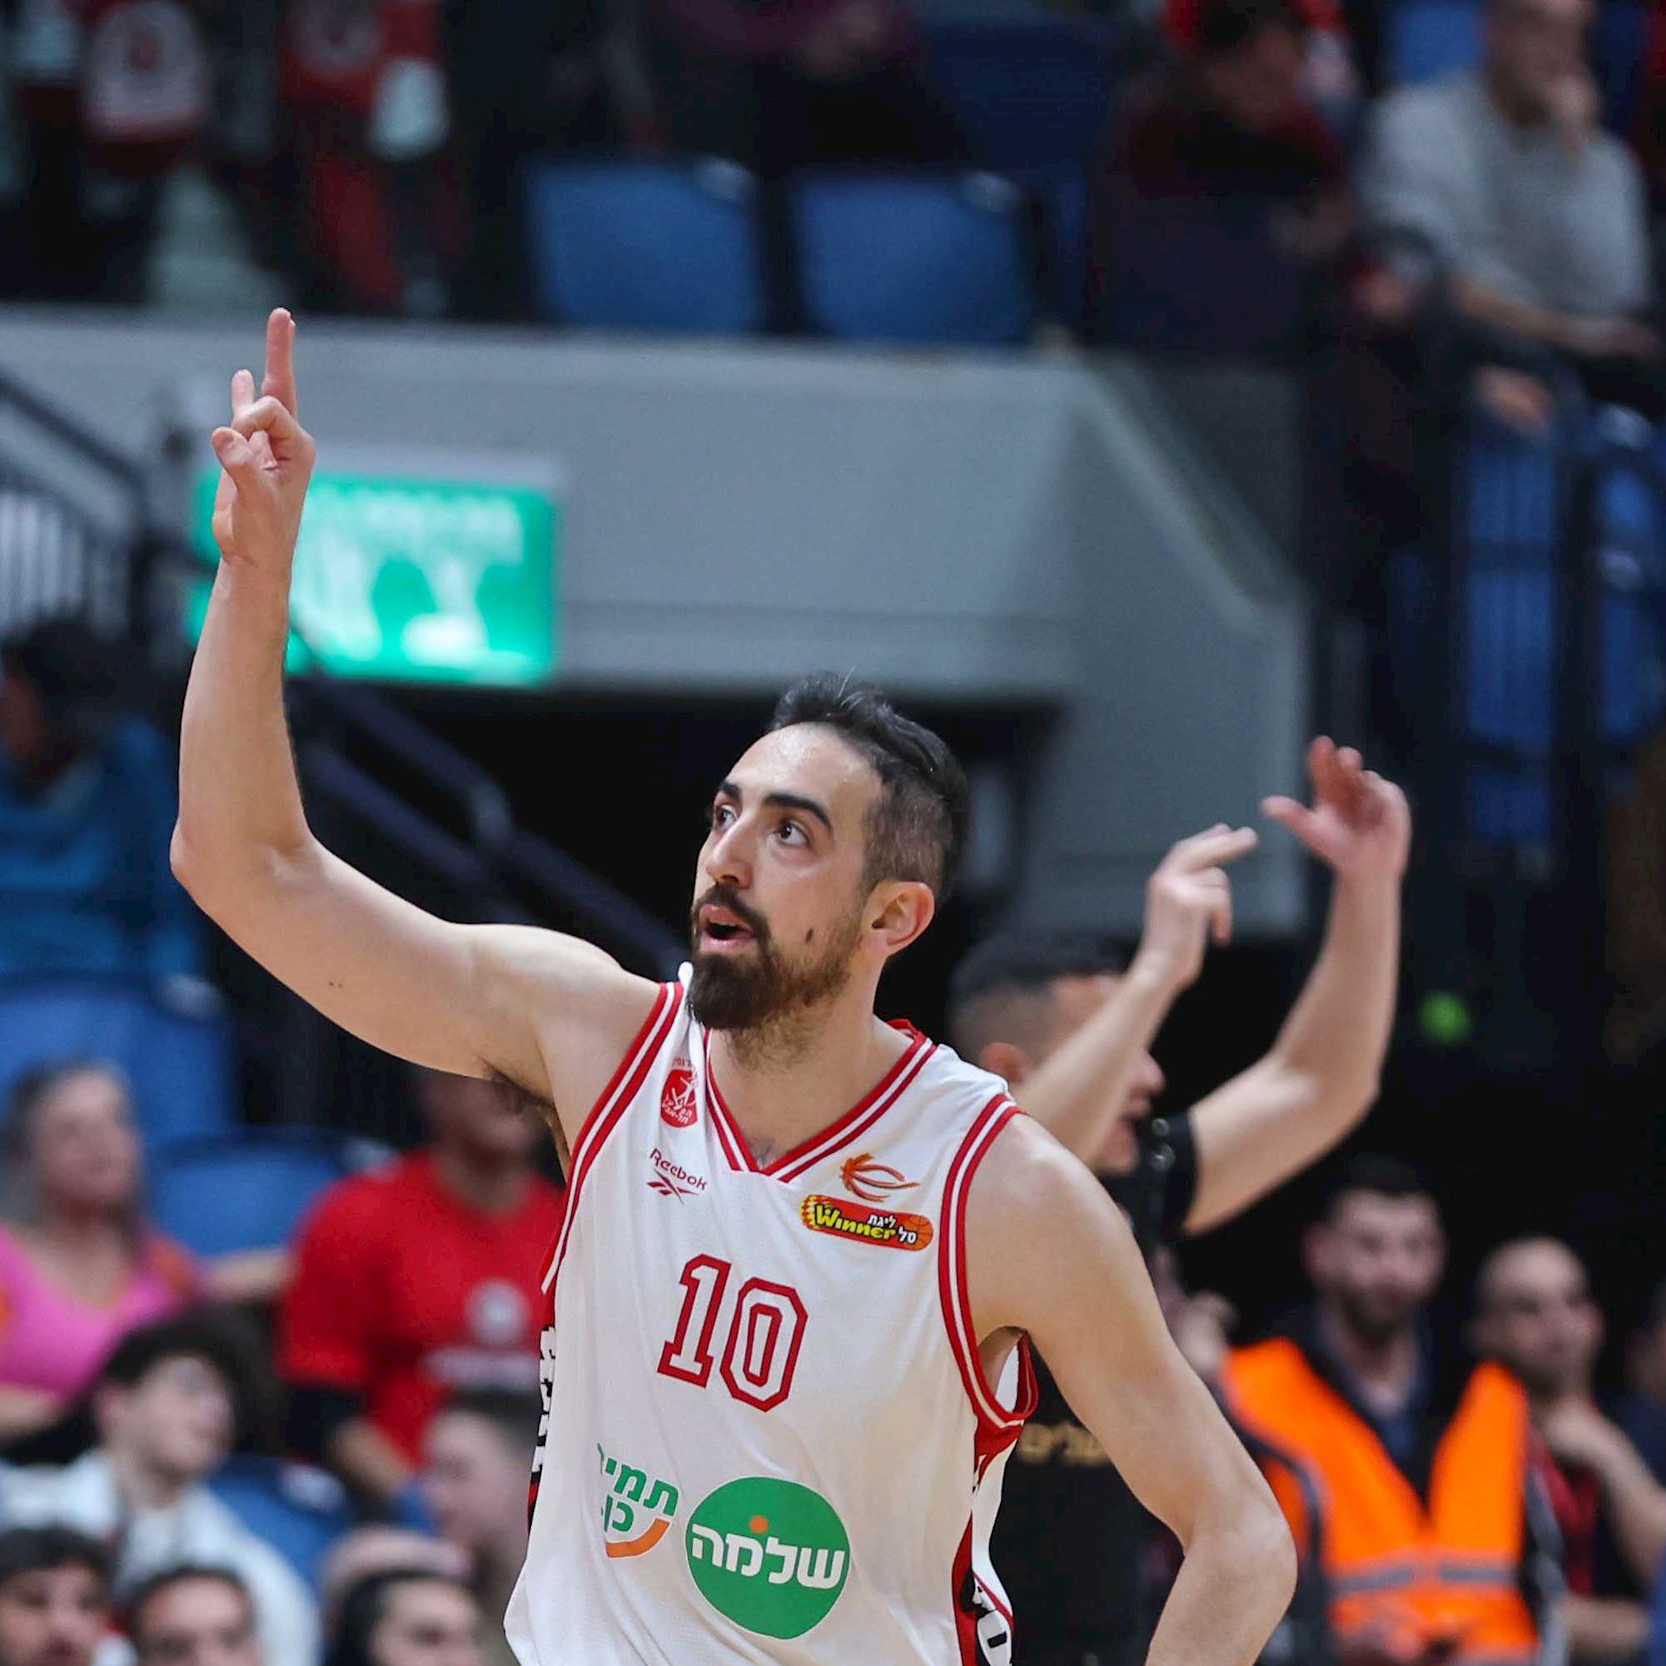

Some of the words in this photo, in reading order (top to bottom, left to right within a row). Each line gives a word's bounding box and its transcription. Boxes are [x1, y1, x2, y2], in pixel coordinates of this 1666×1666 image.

[649, 1147, 708, 1192] Reebok
[814, 1202, 897, 1241] Winner
[867, 1213, 897, 1228] ליגת
[897, 1224, 918, 1244] סל
[656, 1253, 809, 1413] 10
[691, 1522, 846, 1590] שלמה
